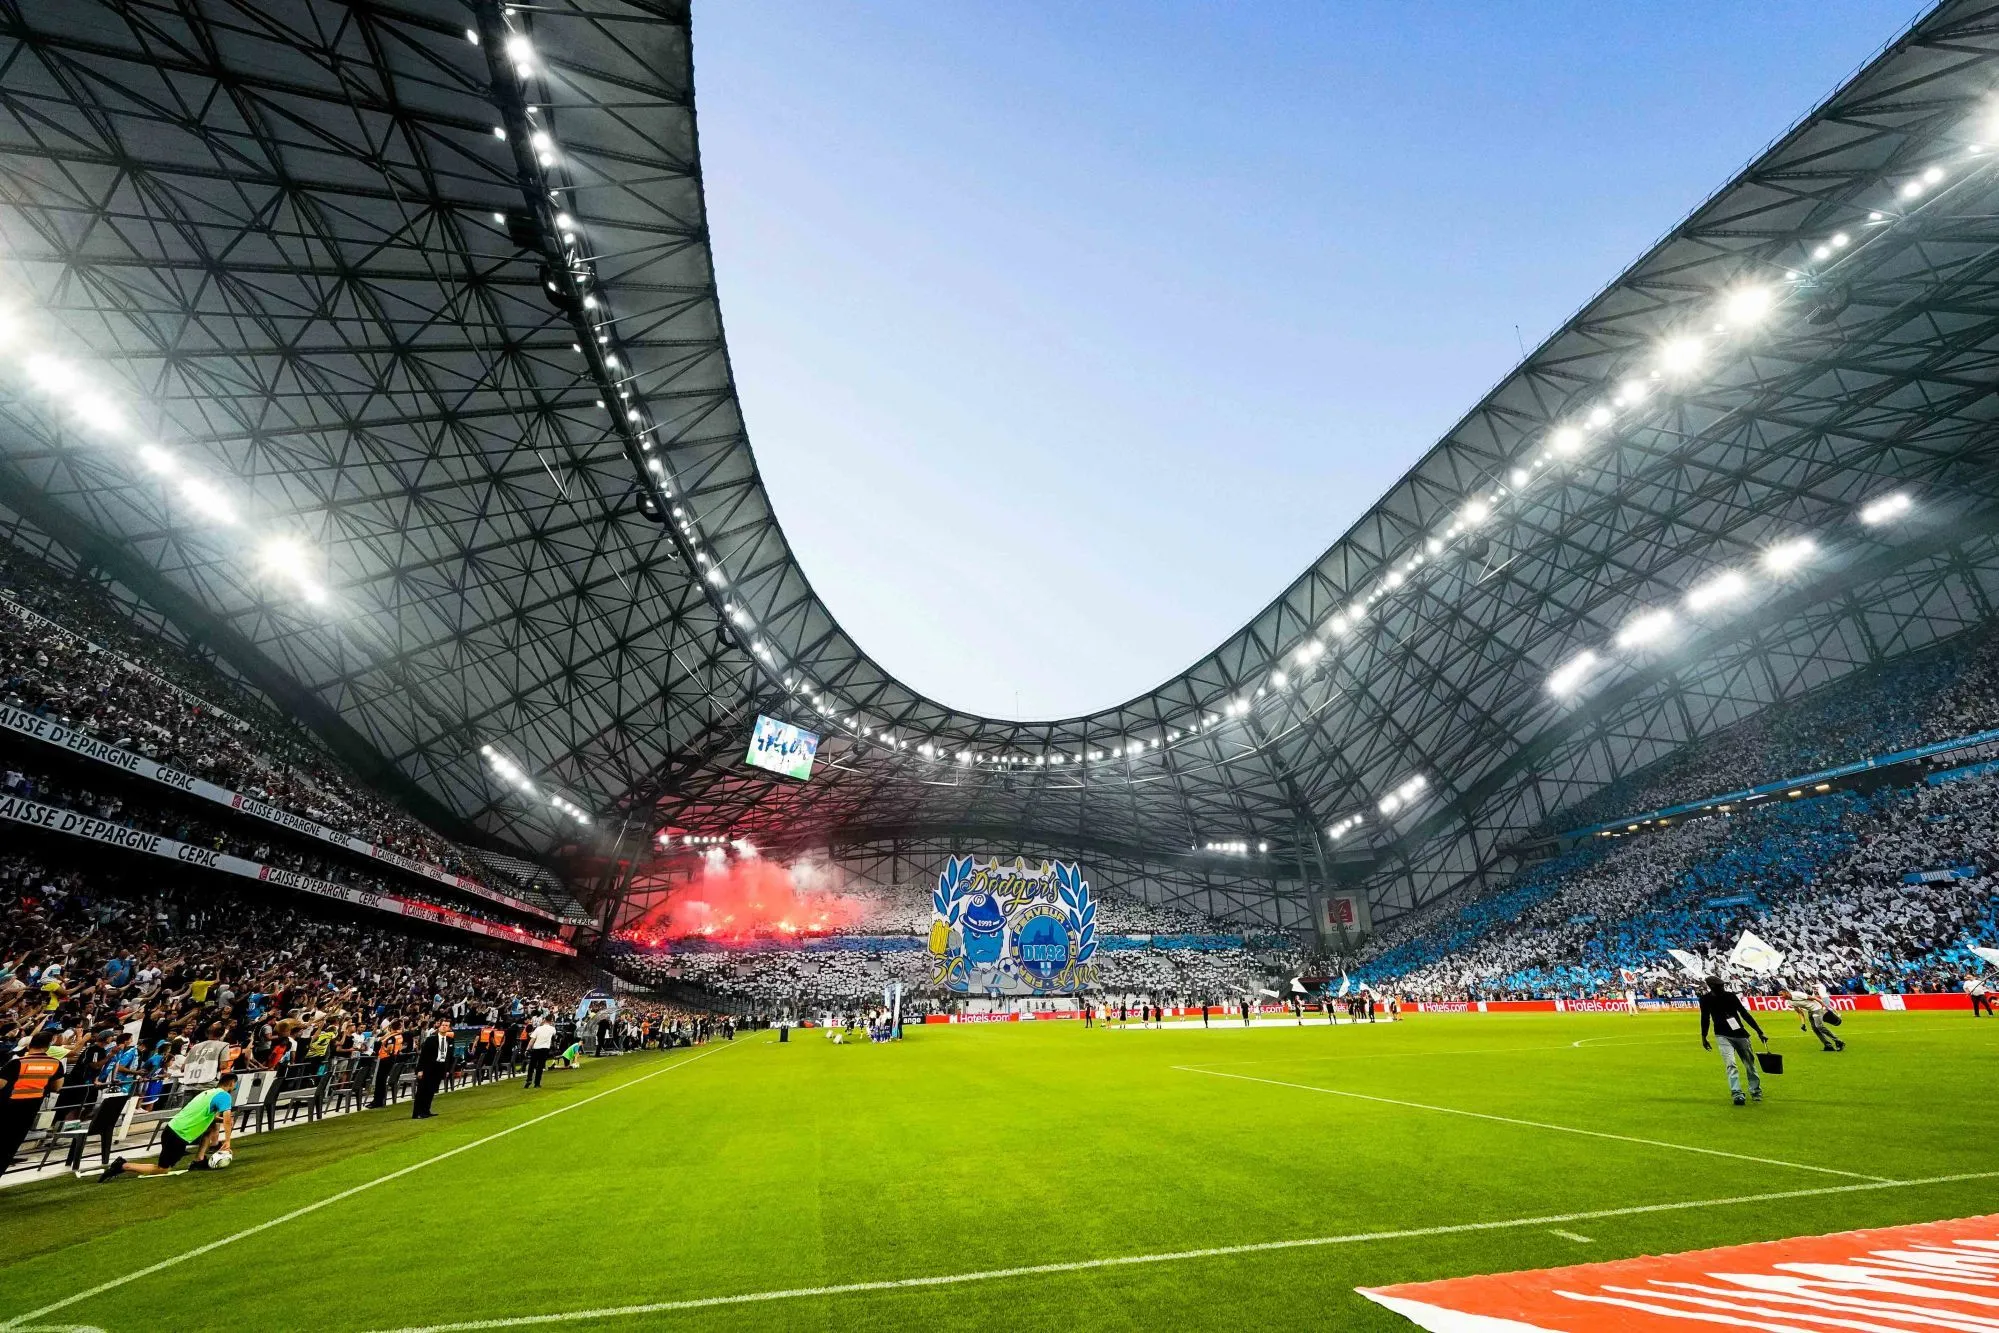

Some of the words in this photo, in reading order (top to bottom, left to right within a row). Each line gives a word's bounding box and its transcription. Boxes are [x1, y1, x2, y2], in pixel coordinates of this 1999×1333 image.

[50, 727, 141, 771] D'EPARGNE
[155, 766, 196, 791] CEPAC
[241, 799, 272, 820] CAISSE
[273, 807, 320, 836] D'EPARGNE
[329, 831, 351, 848] CEPAC
[61, 813, 162, 853] D'EPARGNE
[178, 844, 221, 868] CEPAC
[377, 849, 398, 865] CAISSE
[429, 867, 444, 881] CEPAC
[269, 868, 300, 889] CAISSE
[301, 876, 352, 900] D'EPARGNE
[358, 891, 380, 908] CEPAC
[407, 905, 425, 920] CAISSE
[1331, 924, 1354, 932] CAC
[1022, 943, 1066, 962] DM92
[930, 953, 965, 985] 30
[961, 1013, 1010, 1023] Hotels.com
[1425, 1002, 1468, 1012] Hotels.com
[1567, 1000, 1629, 1012] Hotels.com
